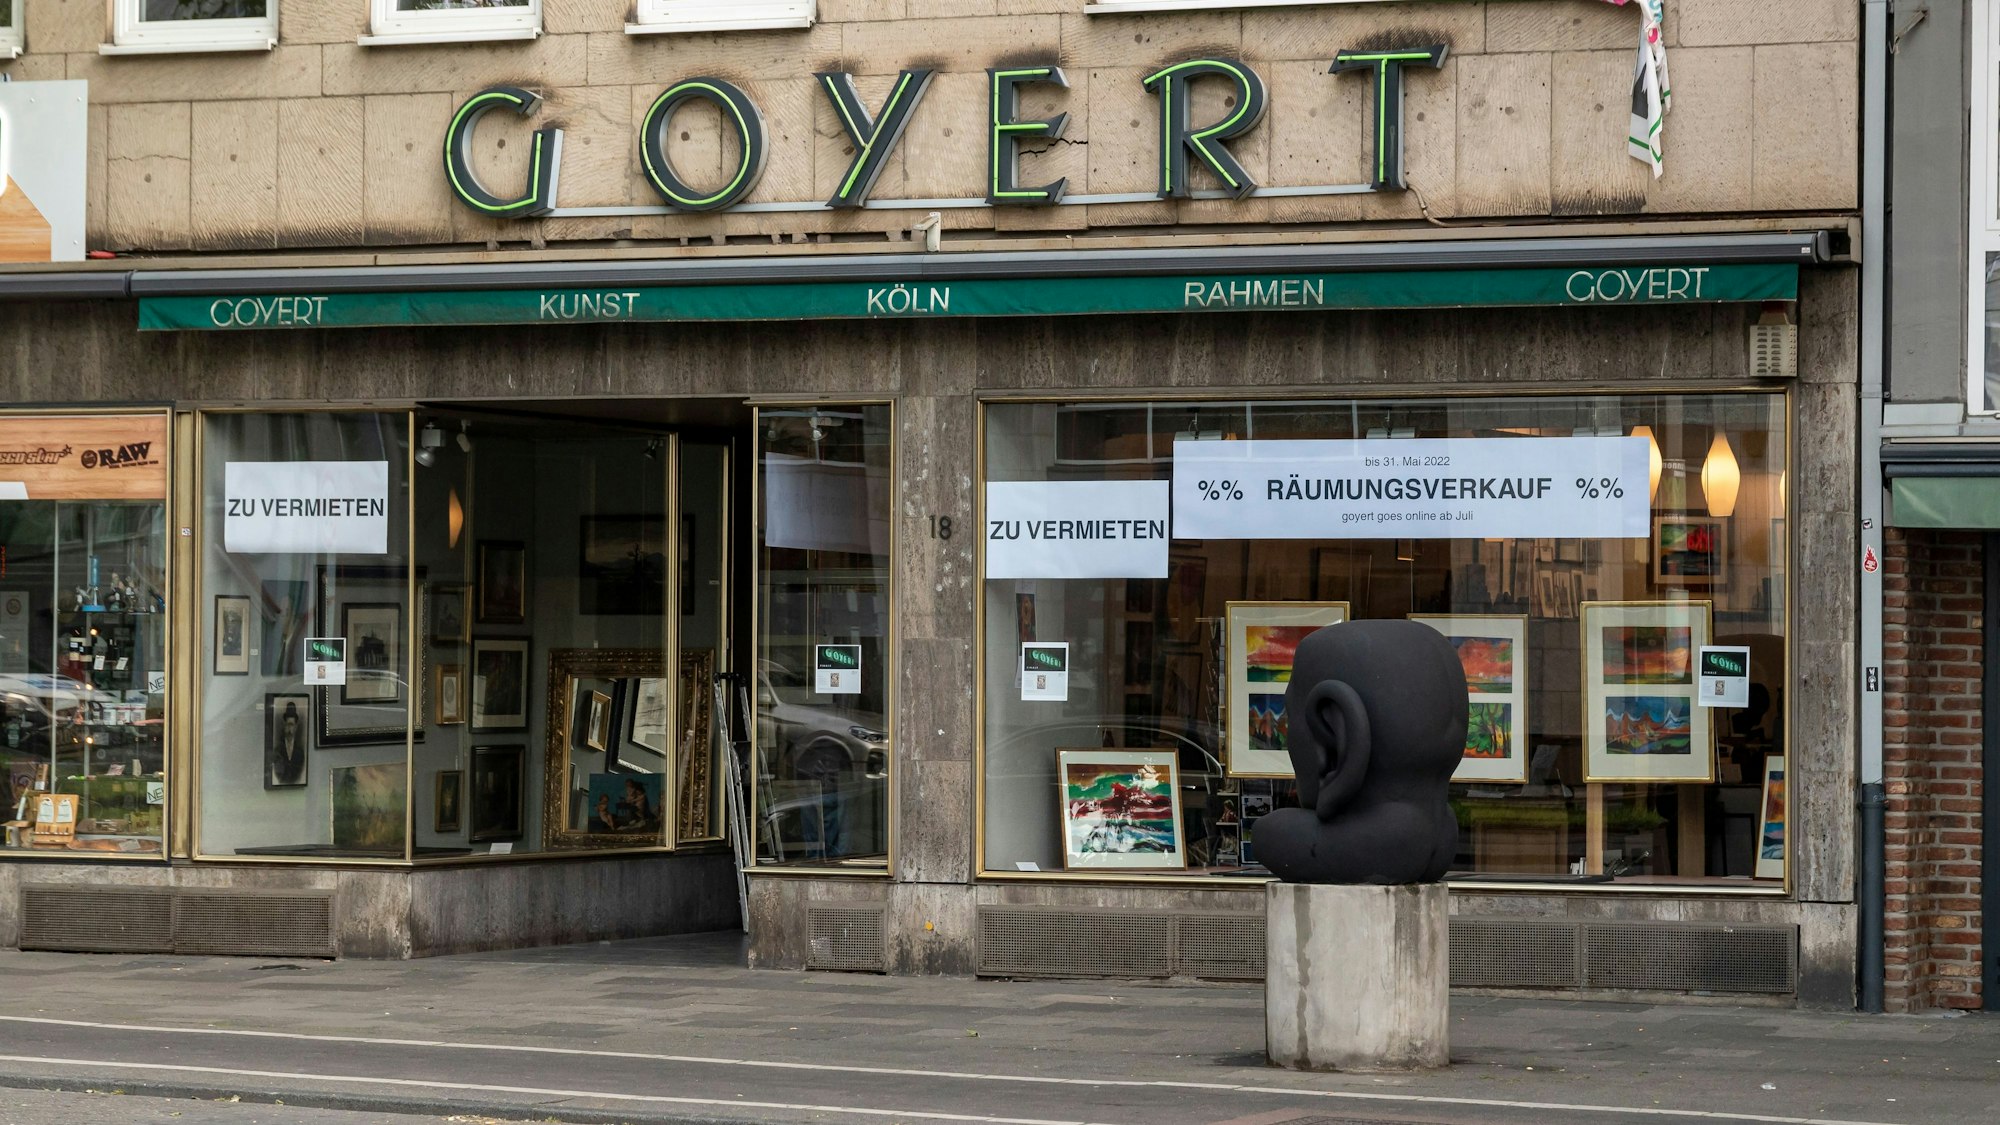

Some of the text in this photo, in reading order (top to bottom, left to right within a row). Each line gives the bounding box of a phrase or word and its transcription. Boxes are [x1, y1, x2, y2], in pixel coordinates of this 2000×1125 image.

[443, 43, 1448, 218] GOYERT
[210, 267, 1710, 327] GOYERT KUNST KÖLN RAHMEN GOYERT
[99, 442, 151, 466] RAW
[1365, 457, 1450, 467] bis 31. Mai 2022
[1198, 474, 1624, 501] %% RÄUMUNGSVERKAUF %%
[228, 498, 384, 517] ZU VERMIETEN
[1341, 511, 1473, 523] goyert goes online ab Juli
[929, 515, 951, 539] 18
[990, 520, 1165, 540] ZU VERMIETEN
[149, 676, 164, 691] NE
[147, 787, 163, 801] NE
